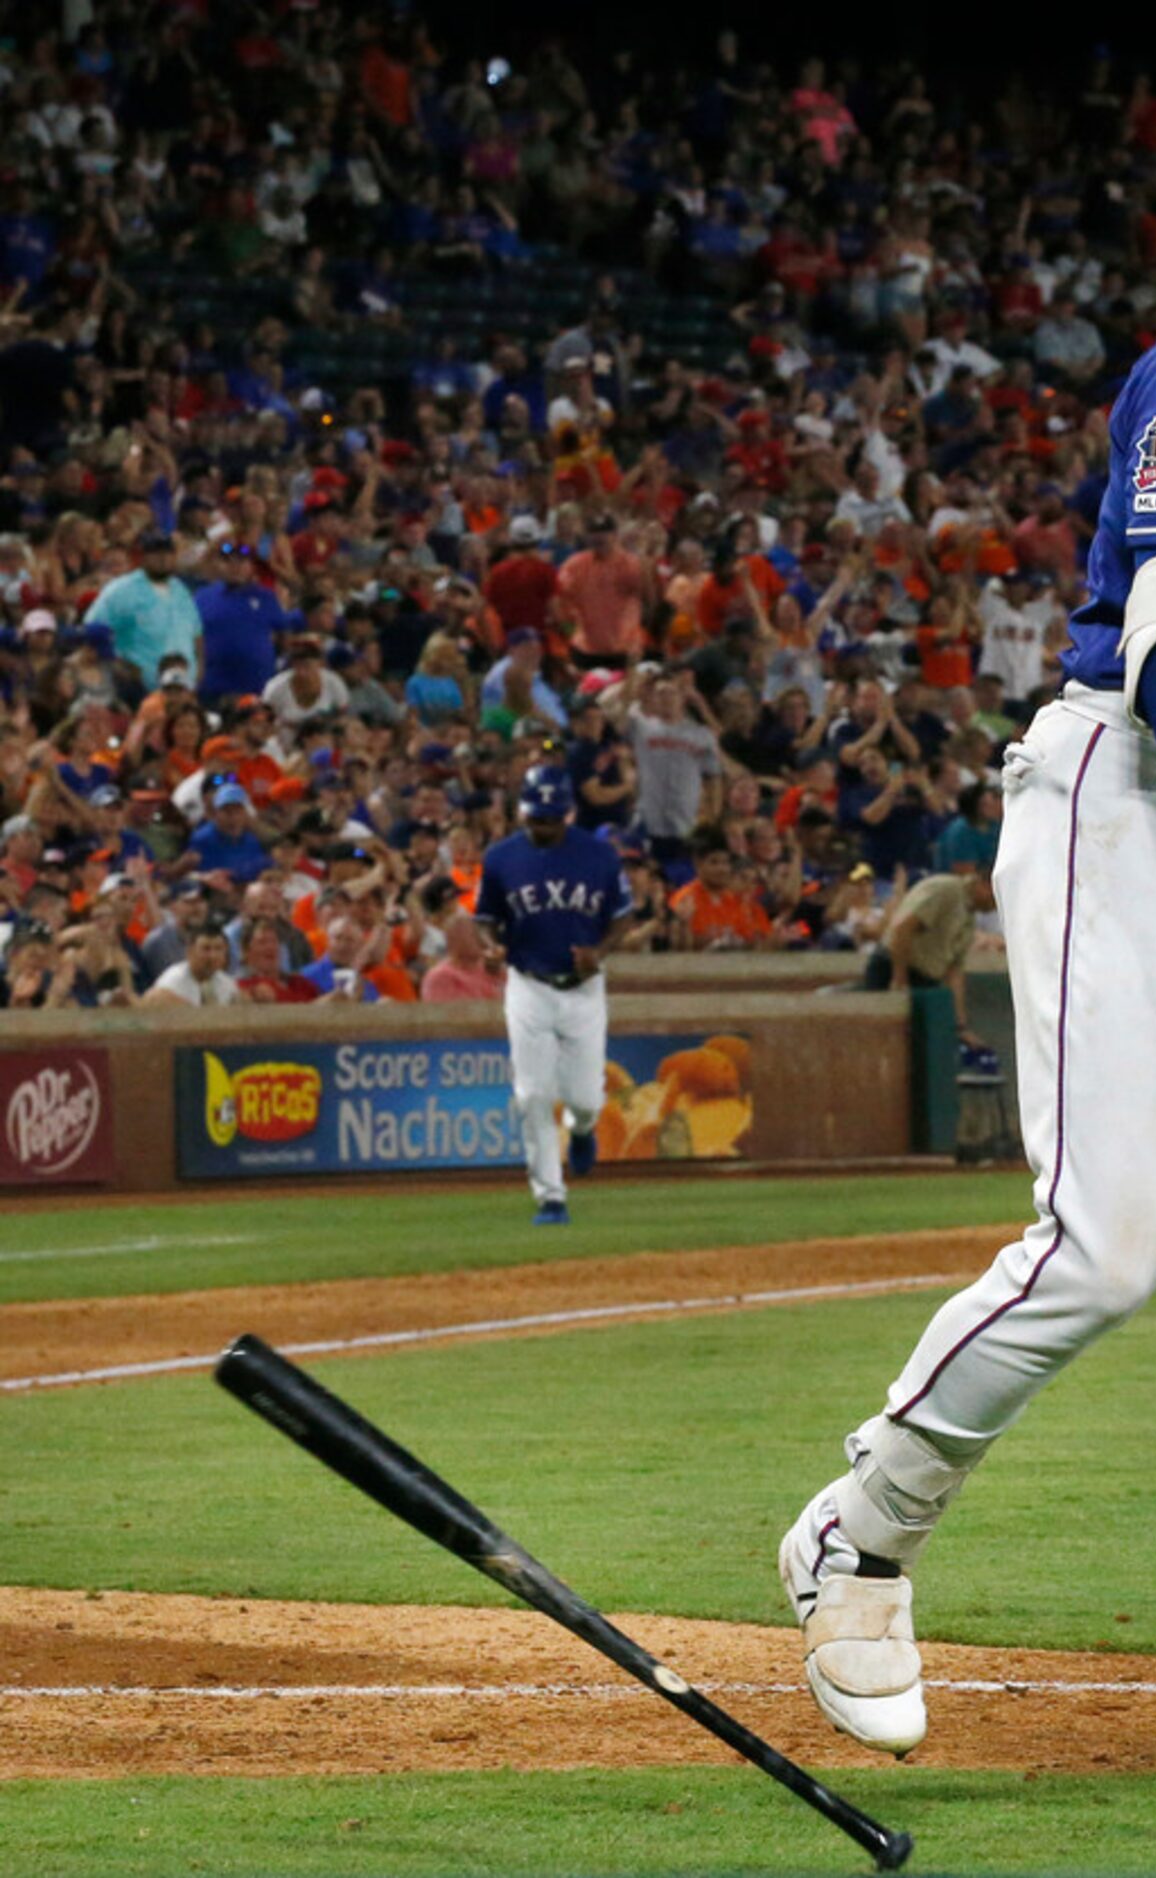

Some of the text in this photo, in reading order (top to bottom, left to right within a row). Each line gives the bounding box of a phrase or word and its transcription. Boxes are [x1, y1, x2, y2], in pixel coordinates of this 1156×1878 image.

[537, 784, 555, 804] T
[505, 879, 605, 920] TEXAS
[38, 1067, 71, 1113] Dr
[334, 1045, 430, 1090] Score
[337, 1095, 520, 1163] Nachos!
